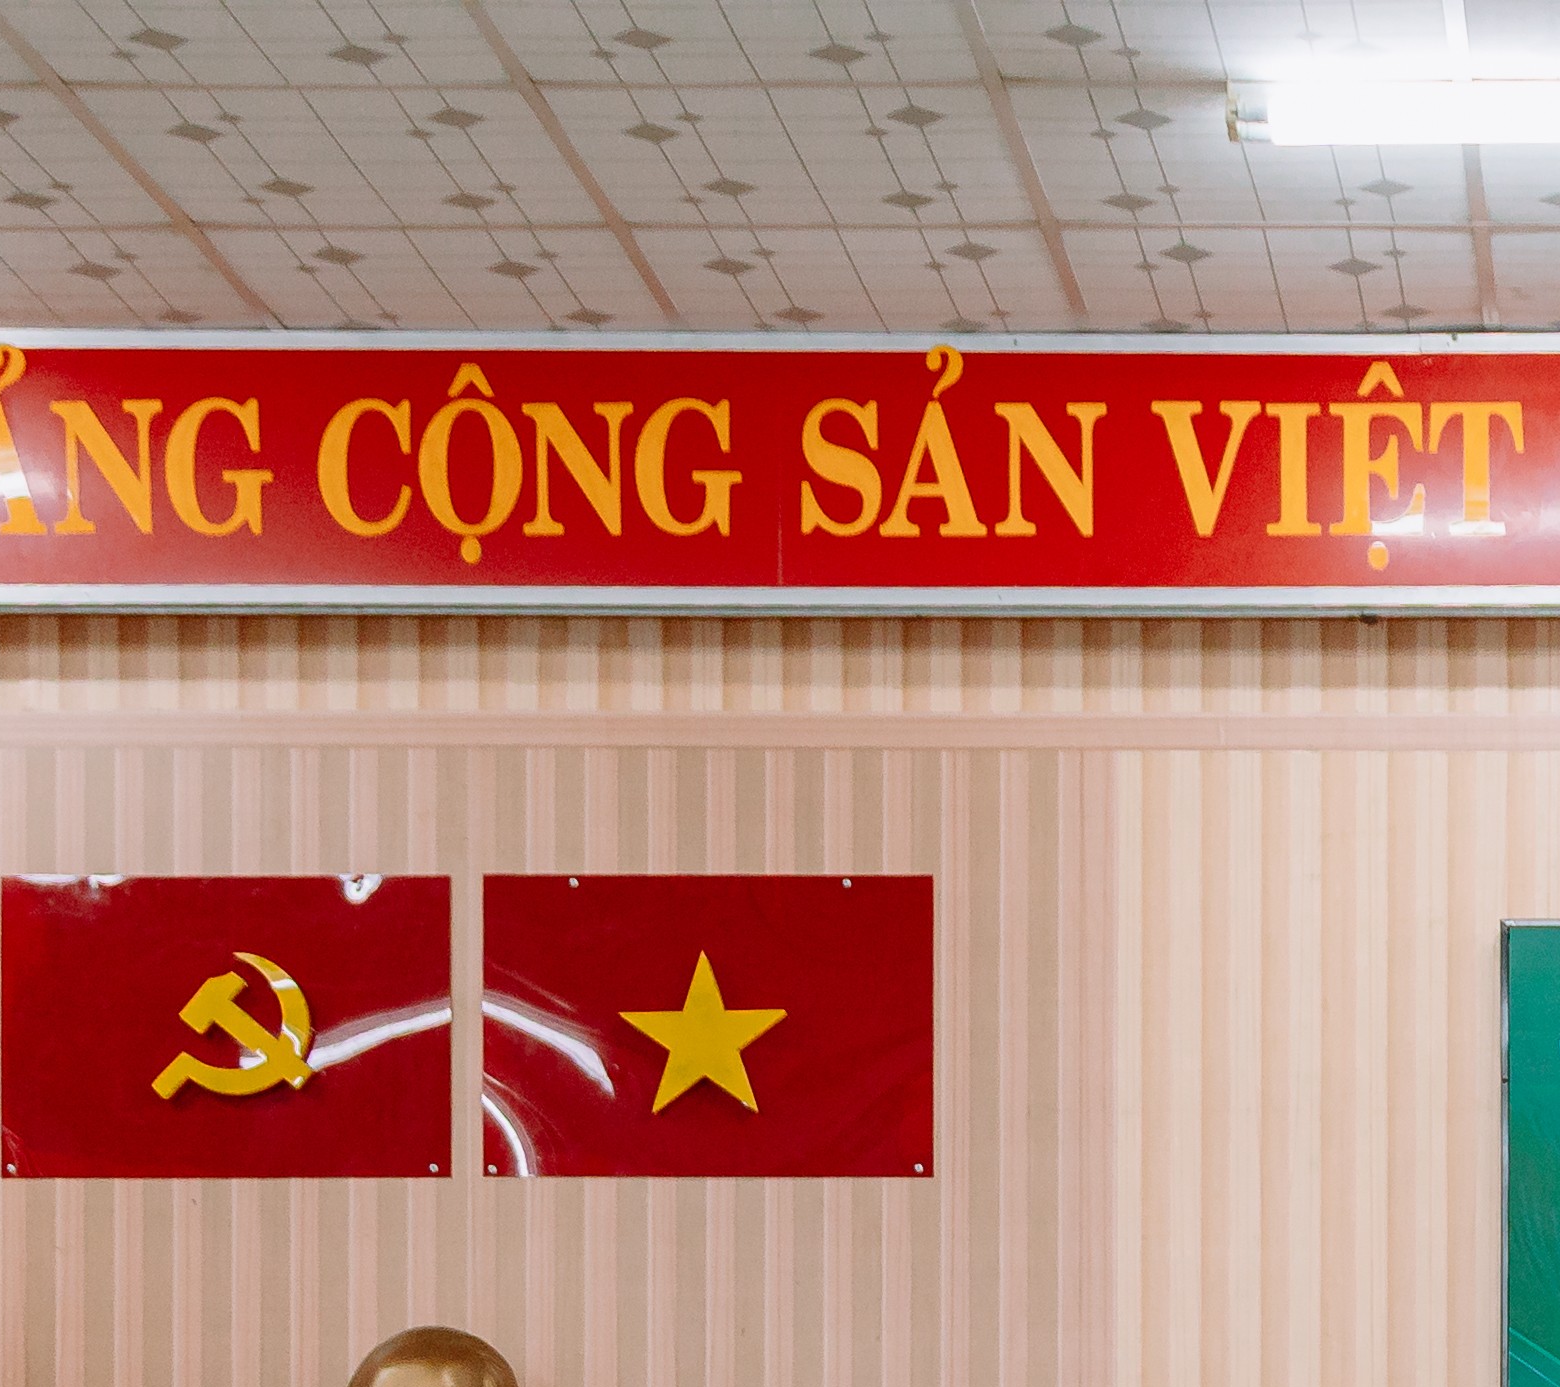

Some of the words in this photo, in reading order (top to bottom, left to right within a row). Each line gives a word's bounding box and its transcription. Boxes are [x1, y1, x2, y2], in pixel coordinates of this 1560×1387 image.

[318, 363, 735, 564] CỘNG
[800, 345, 1102, 538] SẢN
[1152, 362, 1526, 570] VIỆT
